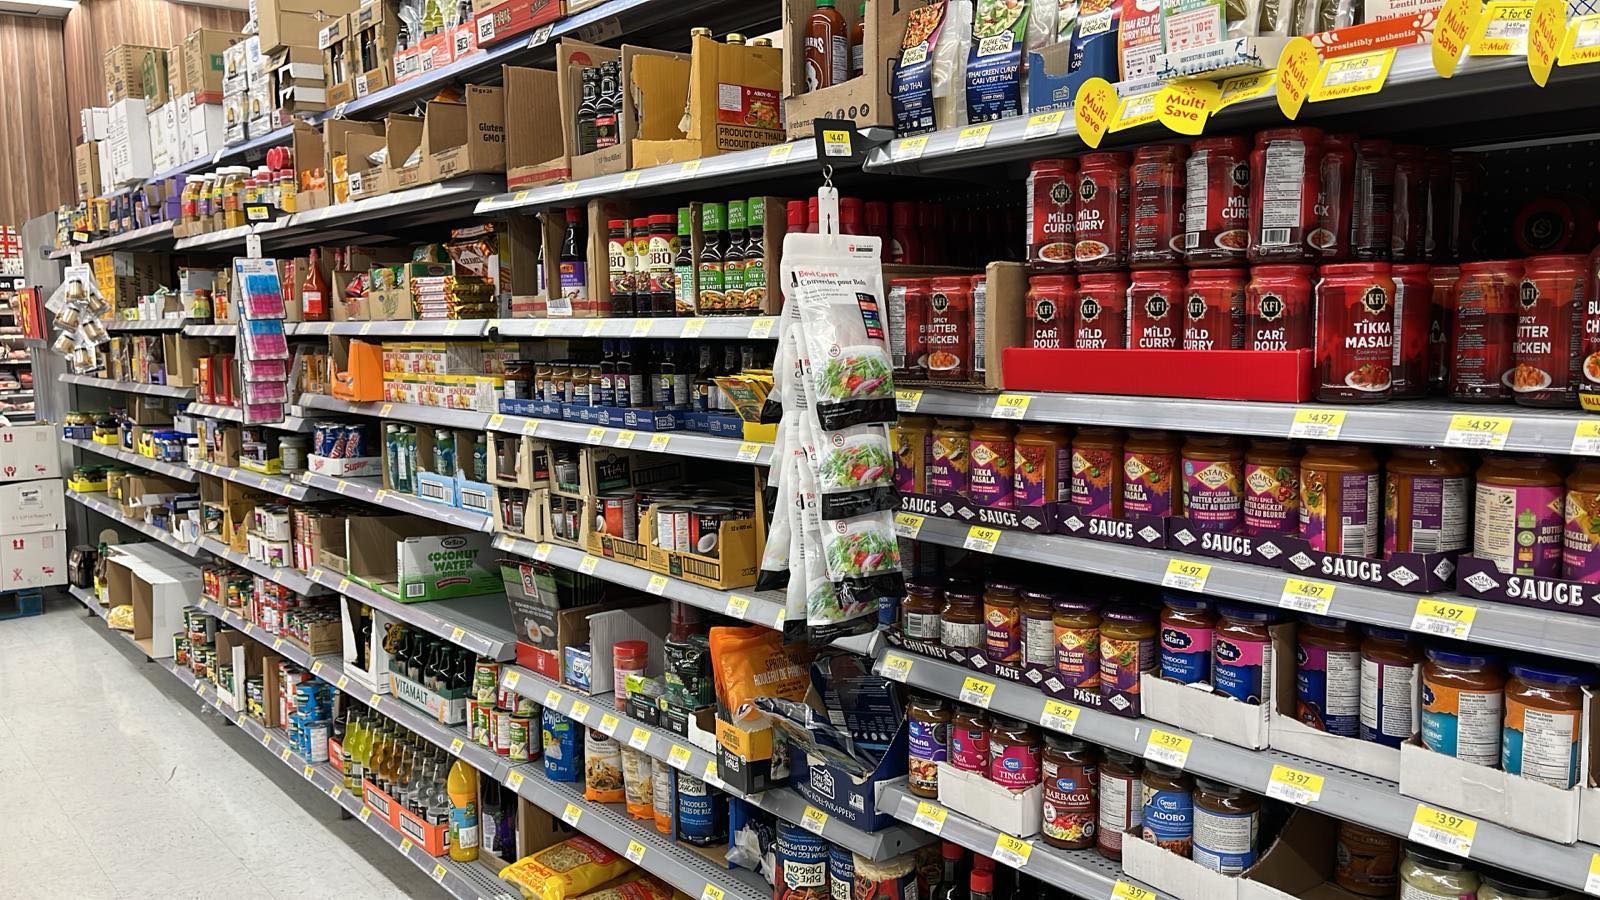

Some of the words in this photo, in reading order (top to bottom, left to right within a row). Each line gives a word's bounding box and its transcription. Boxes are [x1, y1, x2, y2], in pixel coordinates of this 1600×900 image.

[1500, 9, 1506, 18] 2
[1508, 9, 1522, 18] for
[1137, 18, 1150, 29] RED
[1444, 9, 1469, 41] Multi
[1170, 30, 1174, 39] 3
[1196, 22, 1204, 32] 10
[1536, 12, 1557, 51] Multi
[1326, 39, 1372, 53] Irresistibly
[1375, 30, 1416, 43] authentic
[1438, 28, 1458, 57] Save
[981, 44, 1008, 54] DRAGON
[1532, 31, 1549, 65] Save
[1126, 60, 1130, 69] 3
[968, 71, 980, 79] THAI
[982, 68, 999, 77] GREEN
[1000, 66, 1018, 74] CURRY
[1286, 54, 1308, 89] Multi
[986, 75, 1000, 84] VERT
[1000, 73, 1013, 81] THAI
[899, 84, 910, 92] PAD
[910, 81, 922, 90] THAI
[1282, 70, 1300, 102] Save
[1326, 88, 1350, 96] Multi
[1351, 84, 1372, 92] Save
[1084, 92, 1107, 122] Multi
[1166, 94, 1206, 110] Multi
[1080, 106, 1100, 132] Save
[1164, 106, 1198, 121] Save
[479, 123, 504, 132] Gluten
[484, 134, 500, 142] GMO
[720, 127, 752, 138] PRODUCT
[754, 128, 764, 138] OF
[766, 129, 786, 140] THAILA
[719, 139, 750, 149] PRODUIT
[1054, 190, 1068, 198] KFI
[1082, 185, 1093, 195] KFI
[1228, 196, 1248, 207] MIL
[1522, 289, 1535, 298] KFI
[934, 298, 946, 306] KFI
[1368, 294, 1384, 305] KFI
[1039, 304, 1052, 314] KFI
[1084, 304, 1096, 314] KFI
[1150, 302, 1165, 312] KFI
[1190, 303, 1202, 313] KFI
[1263, 301, 1278, 312] KFI
[1144, 326, 1172, 338] MILD
[1354, 320, 1391, 334] TIKKA
[1078, 328, 1102, 339] MILD
[1186, 328, 1209, 340] MILD
[1034, 340, 1060, 349] DOUX
[1076, 339, 1107, 350] CURRY
[1139, 338, 1176, 348] CURRY
[1183, 340, 1214, 350] CURRY
[1254, 342, 1287, 352] DOUX
[1005, 396, 1024, 406] $4.97
[1309, 414, 1335, 424] $4.97
[1468, 420, 1499, 432] $4.97
[974, 468, 992, 476] TIKKA
[902, 496, 937, 514] SAUCE
[1212, 496, 1238, 504] CHICKEN
[1190, 502, 1210, 510] POULET
[1258, 503, 1283, 512] CHICKEN
[979, 508, 1018, 526] SAUCE
[1264, 510, 1286, 519] BEURRE
[1089, 518, 1133, 540] SAUCE
[978, 530, 994, 540] $4.97
[1202, 532, 1252, 556] SAUCE
[428, 550, 480, 562] COCONUT
[434, 560, 474, 572] WATER
[1180, 565, 1202, 576] $4.97
[1322, 556, 1382, 582] SAUCE
[1299, 584, 1324, 596] $4.97
[1506, 576, 1584, 606] SAUCE
[1434, 606, 1464, 620] $4.97
[987, 630, 1008, 638] MADRAS
[1164, 634, 1184, 645] Sitara
[904, 640, 948, 660] CHUTNEY
[1162, 654, 1188, 664] TANDOORI
[995, 664, 1020, 680] PASTE
[396, 677, 428, 706] VITAMALT
[972, 682, 988, 692] $5.47
[1074, 688, 1102, 706] PASTE
[1055, 706, 1072, 717] $5.47
[1162, 735, 1182, 747] $3.97
[1000, 772, 1026, 780] TINGA
[1286, 771, 1310, 785] $3.97
[1046, 788, 1090, 802] BARBACOA
[1160, 799, 1176, 807] Great
[825, 801, 856, 821] WRAPPERS
[1154, 812, 1186, 822] ADOBO
[1436, 812, 1464, 828] $3.97
[1007, 838, 1022, 851] $3.97
[788, 865, 822, 874] DRAGON
[801, 874, 821, 883] BLUE
[1128, 884, 1147, 898] $3.97
